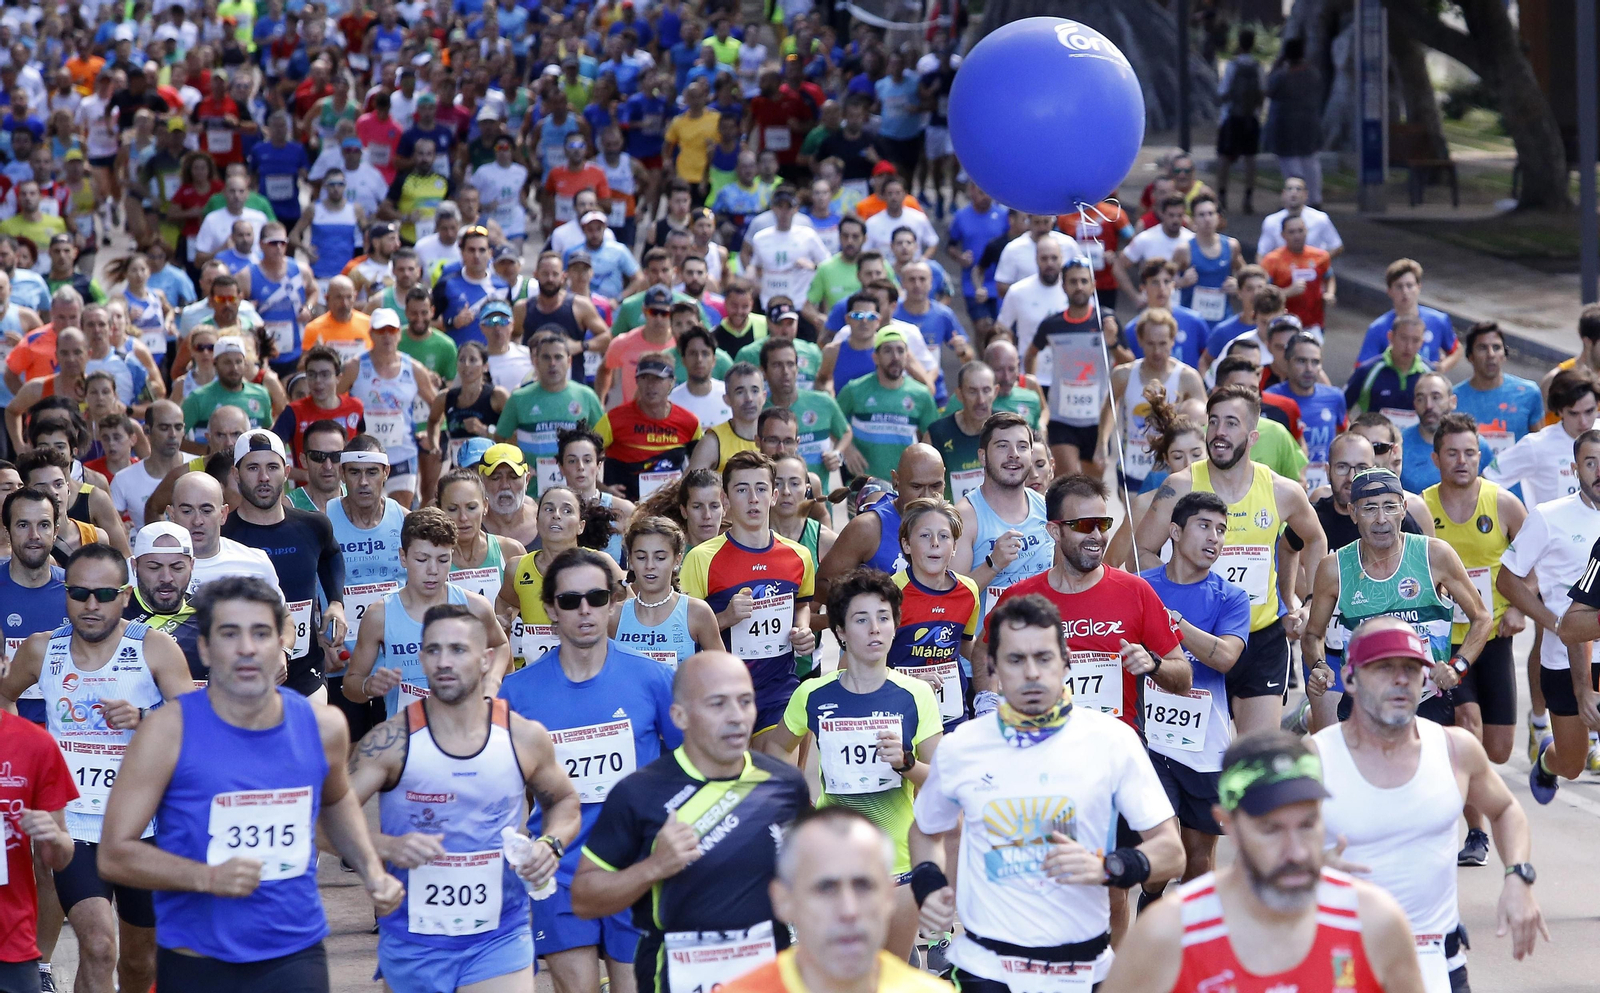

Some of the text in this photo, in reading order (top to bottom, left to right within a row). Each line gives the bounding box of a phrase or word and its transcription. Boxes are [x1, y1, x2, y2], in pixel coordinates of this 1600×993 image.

[1066, 394, 1093, 404] 1369
[374, 423, 395, 433] 307
[1227, 566, 1248, 583] 27
[748, 617, 781, 637] 419
[620, 630, 668, 646] nerja
[1145, 702, 1202, 729] 18291
[821, 721, 834, 732] 41
[565, 751, 623, 779] 2770
[76, 766, 117, 788] 178
[227, 823, 295, 849] 3315
[425, 883, 487, 907] 2303
